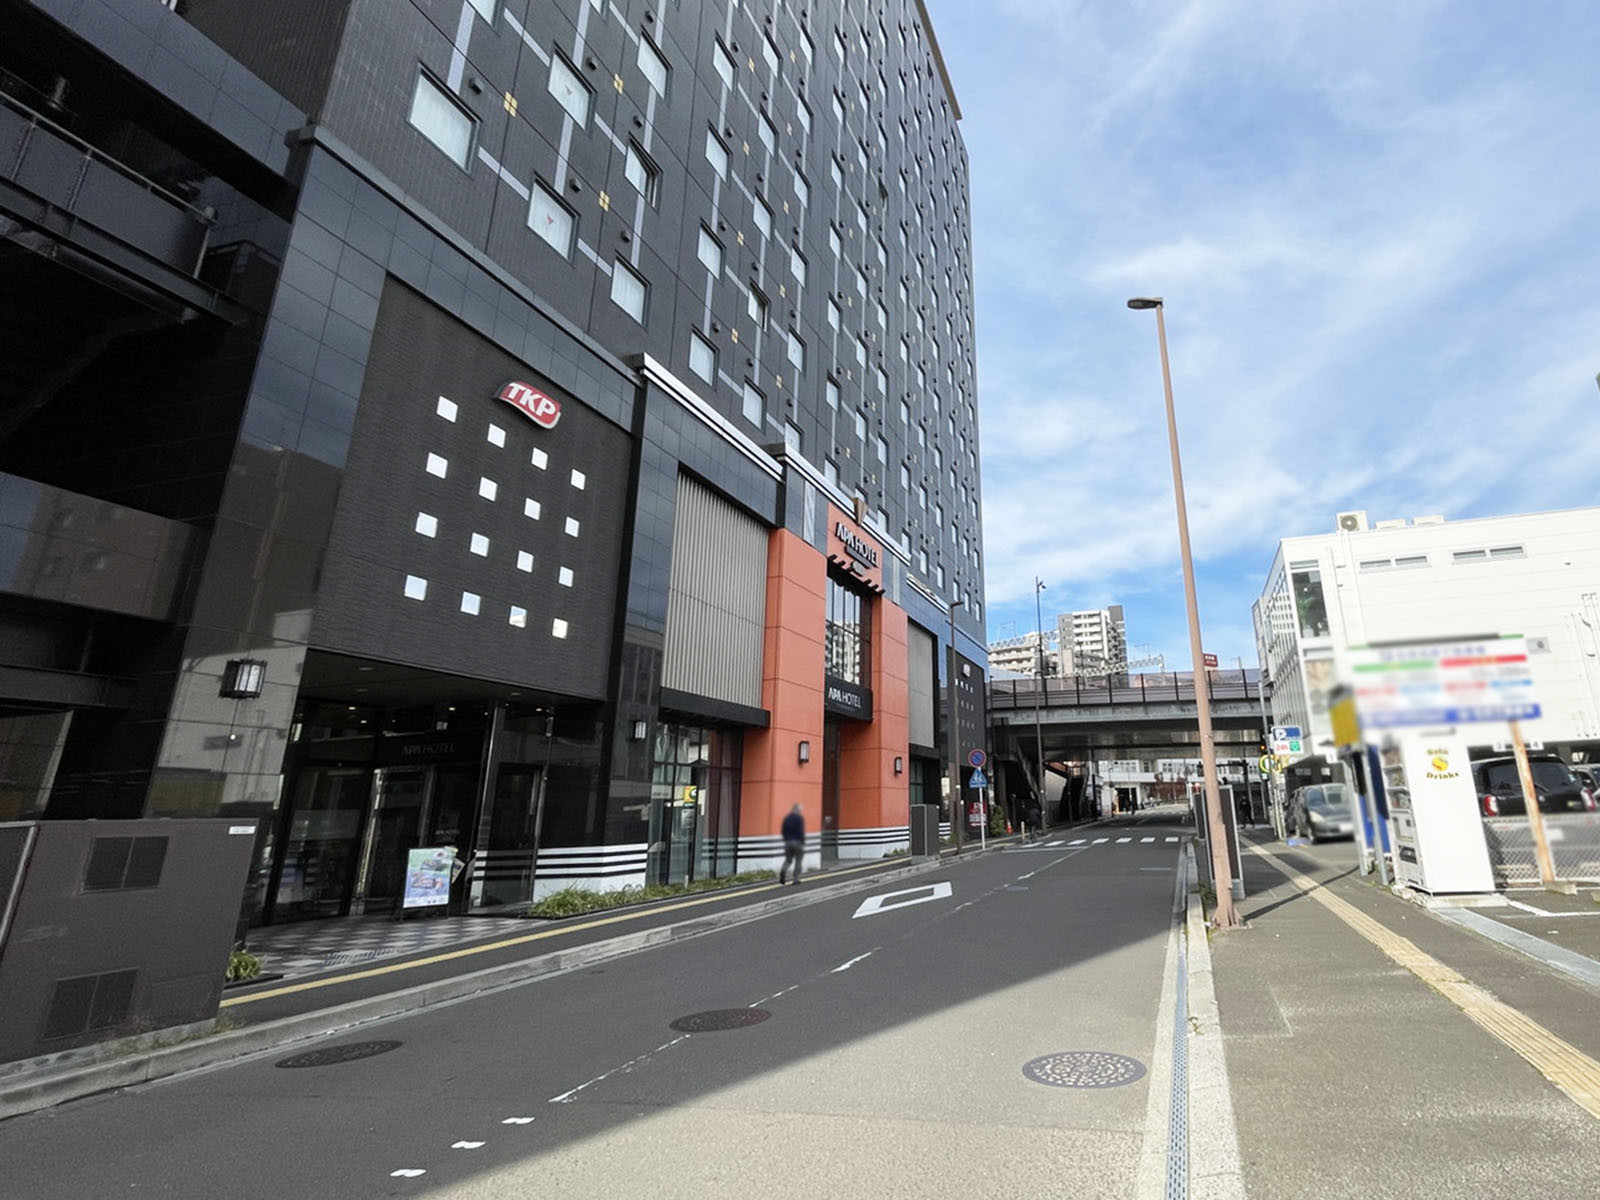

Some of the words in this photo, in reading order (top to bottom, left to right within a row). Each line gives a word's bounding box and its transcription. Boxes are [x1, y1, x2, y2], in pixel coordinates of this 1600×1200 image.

[508, 382, 556, 416] TKP
[842, 691, 862, 708] HOTEL
[423, 743, 456, 754] HOTEL
